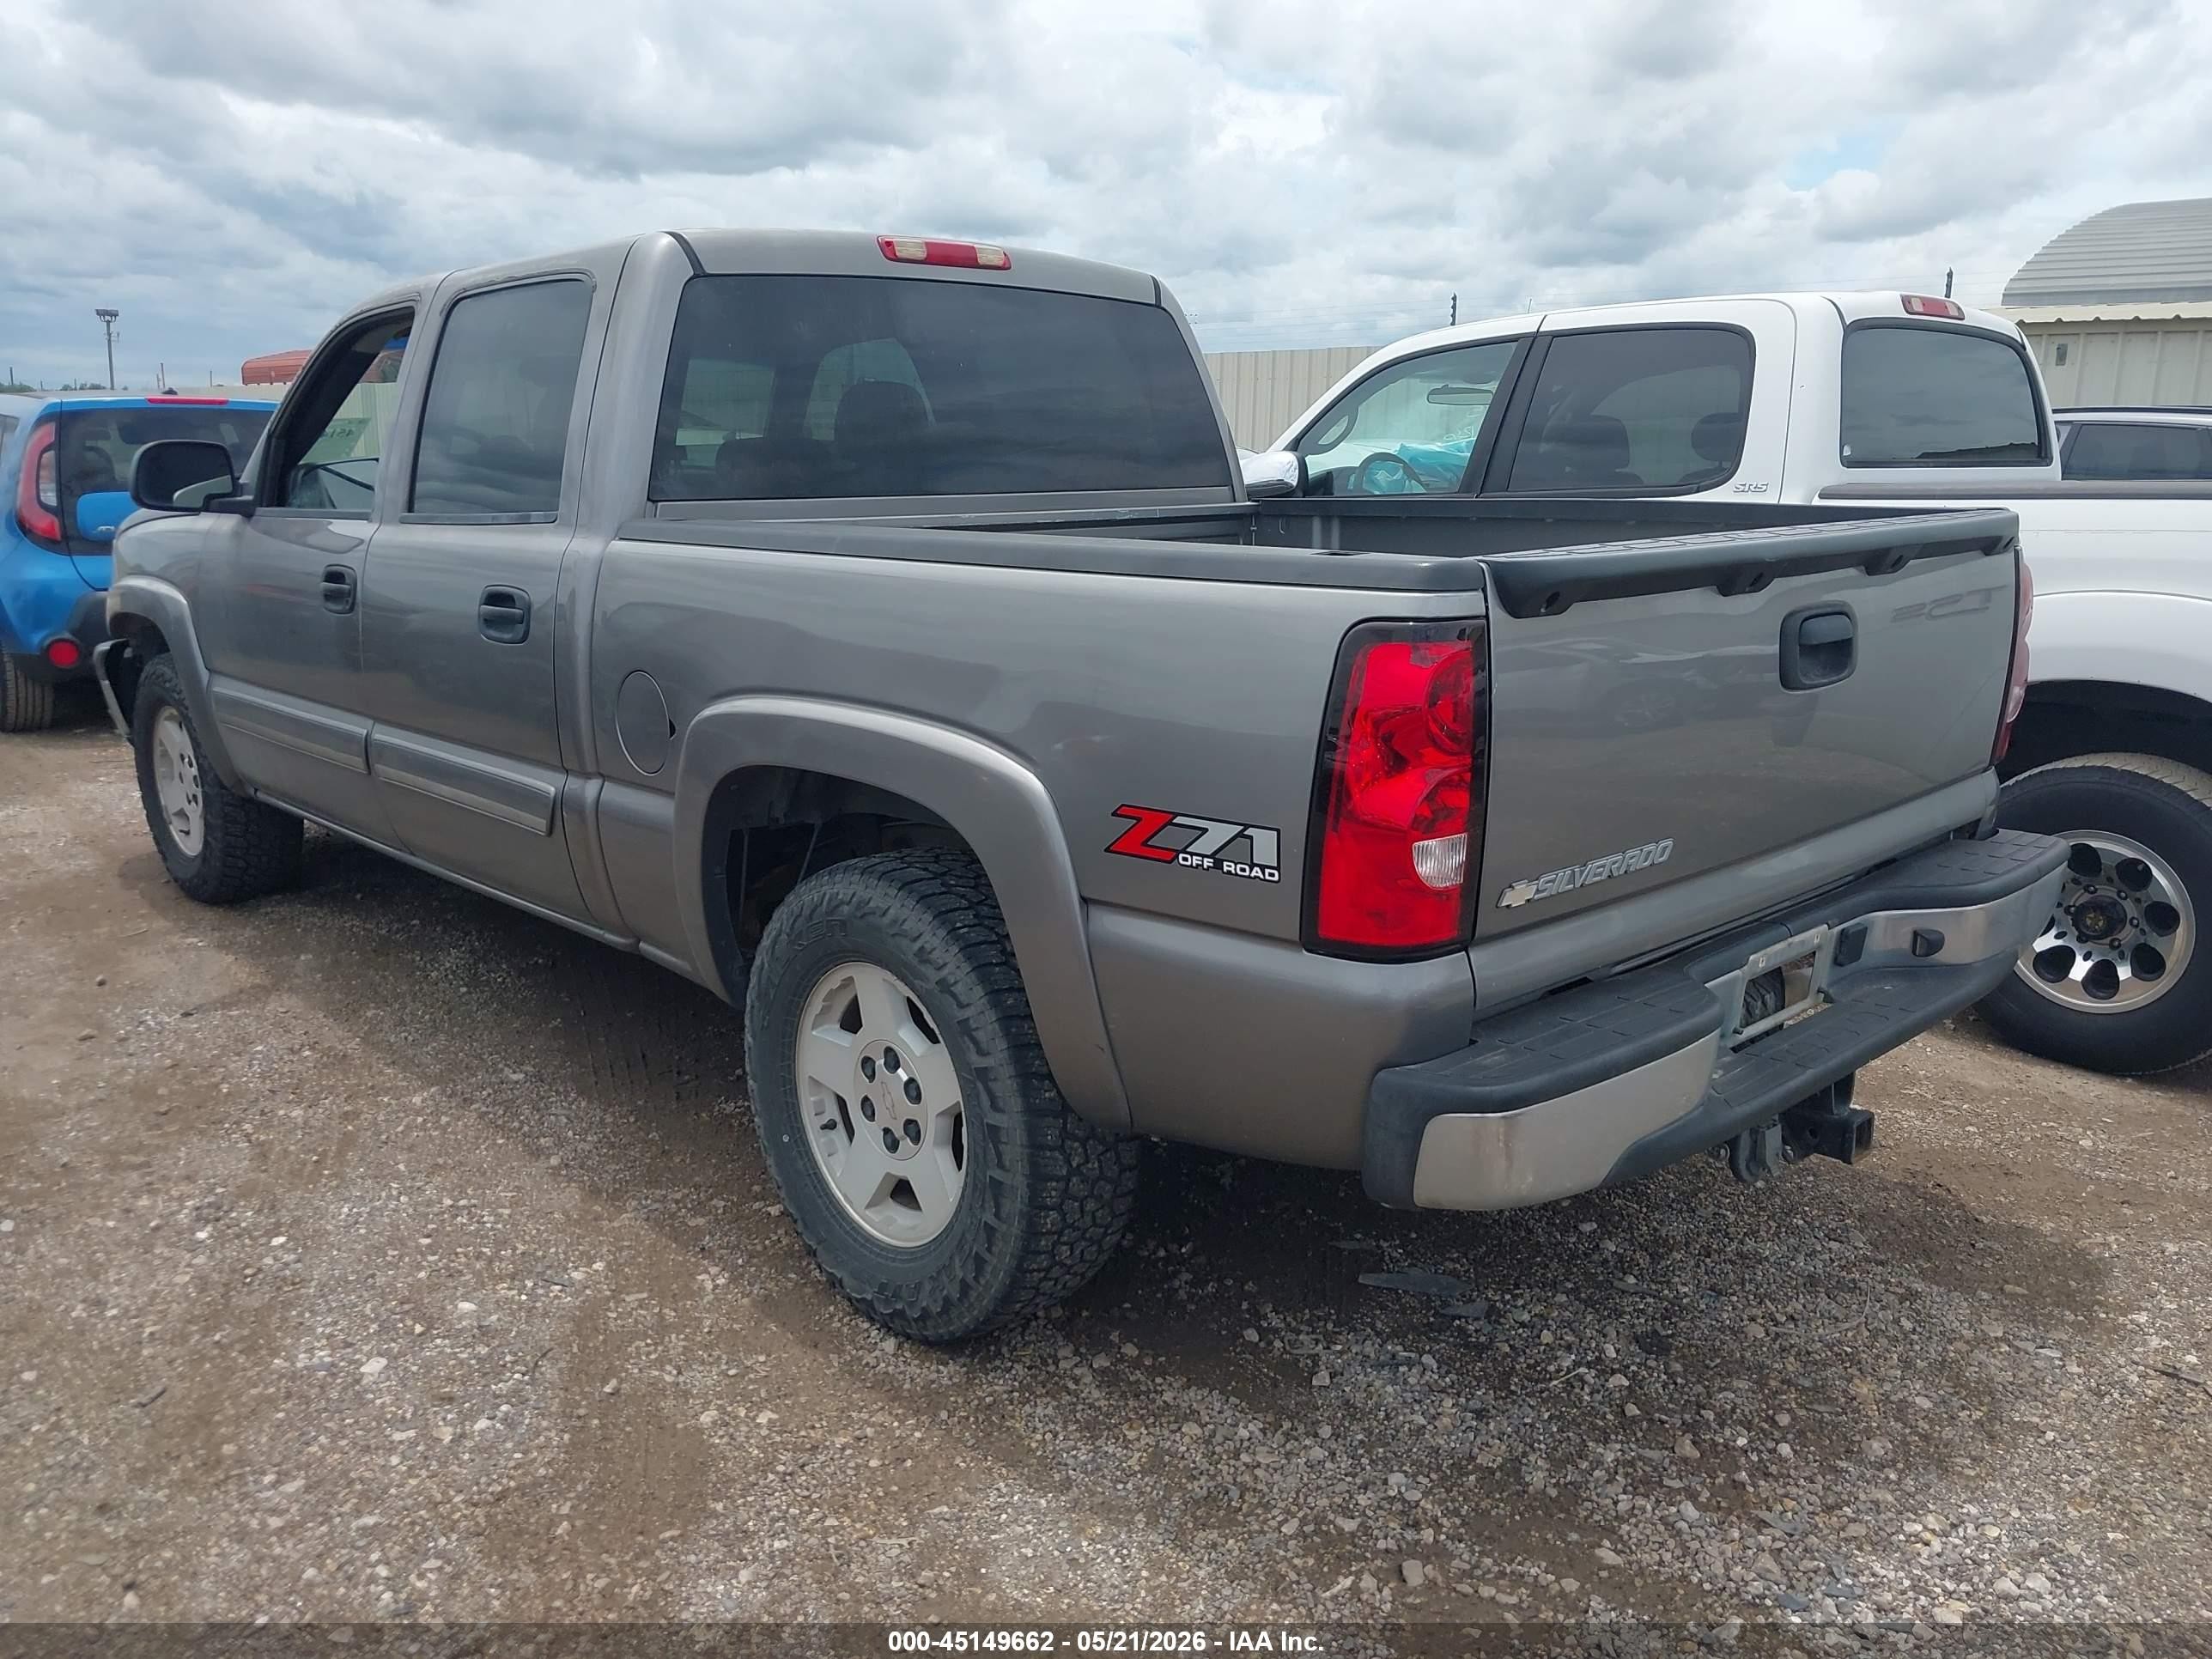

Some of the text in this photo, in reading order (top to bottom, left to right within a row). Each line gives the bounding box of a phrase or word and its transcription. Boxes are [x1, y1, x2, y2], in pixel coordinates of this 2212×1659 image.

[1103, 804, 1281, 866] Z71
[1177, 853, 1280, 883] OFF ROAD
[1533, 838, 1675, 900] SILVERADO
